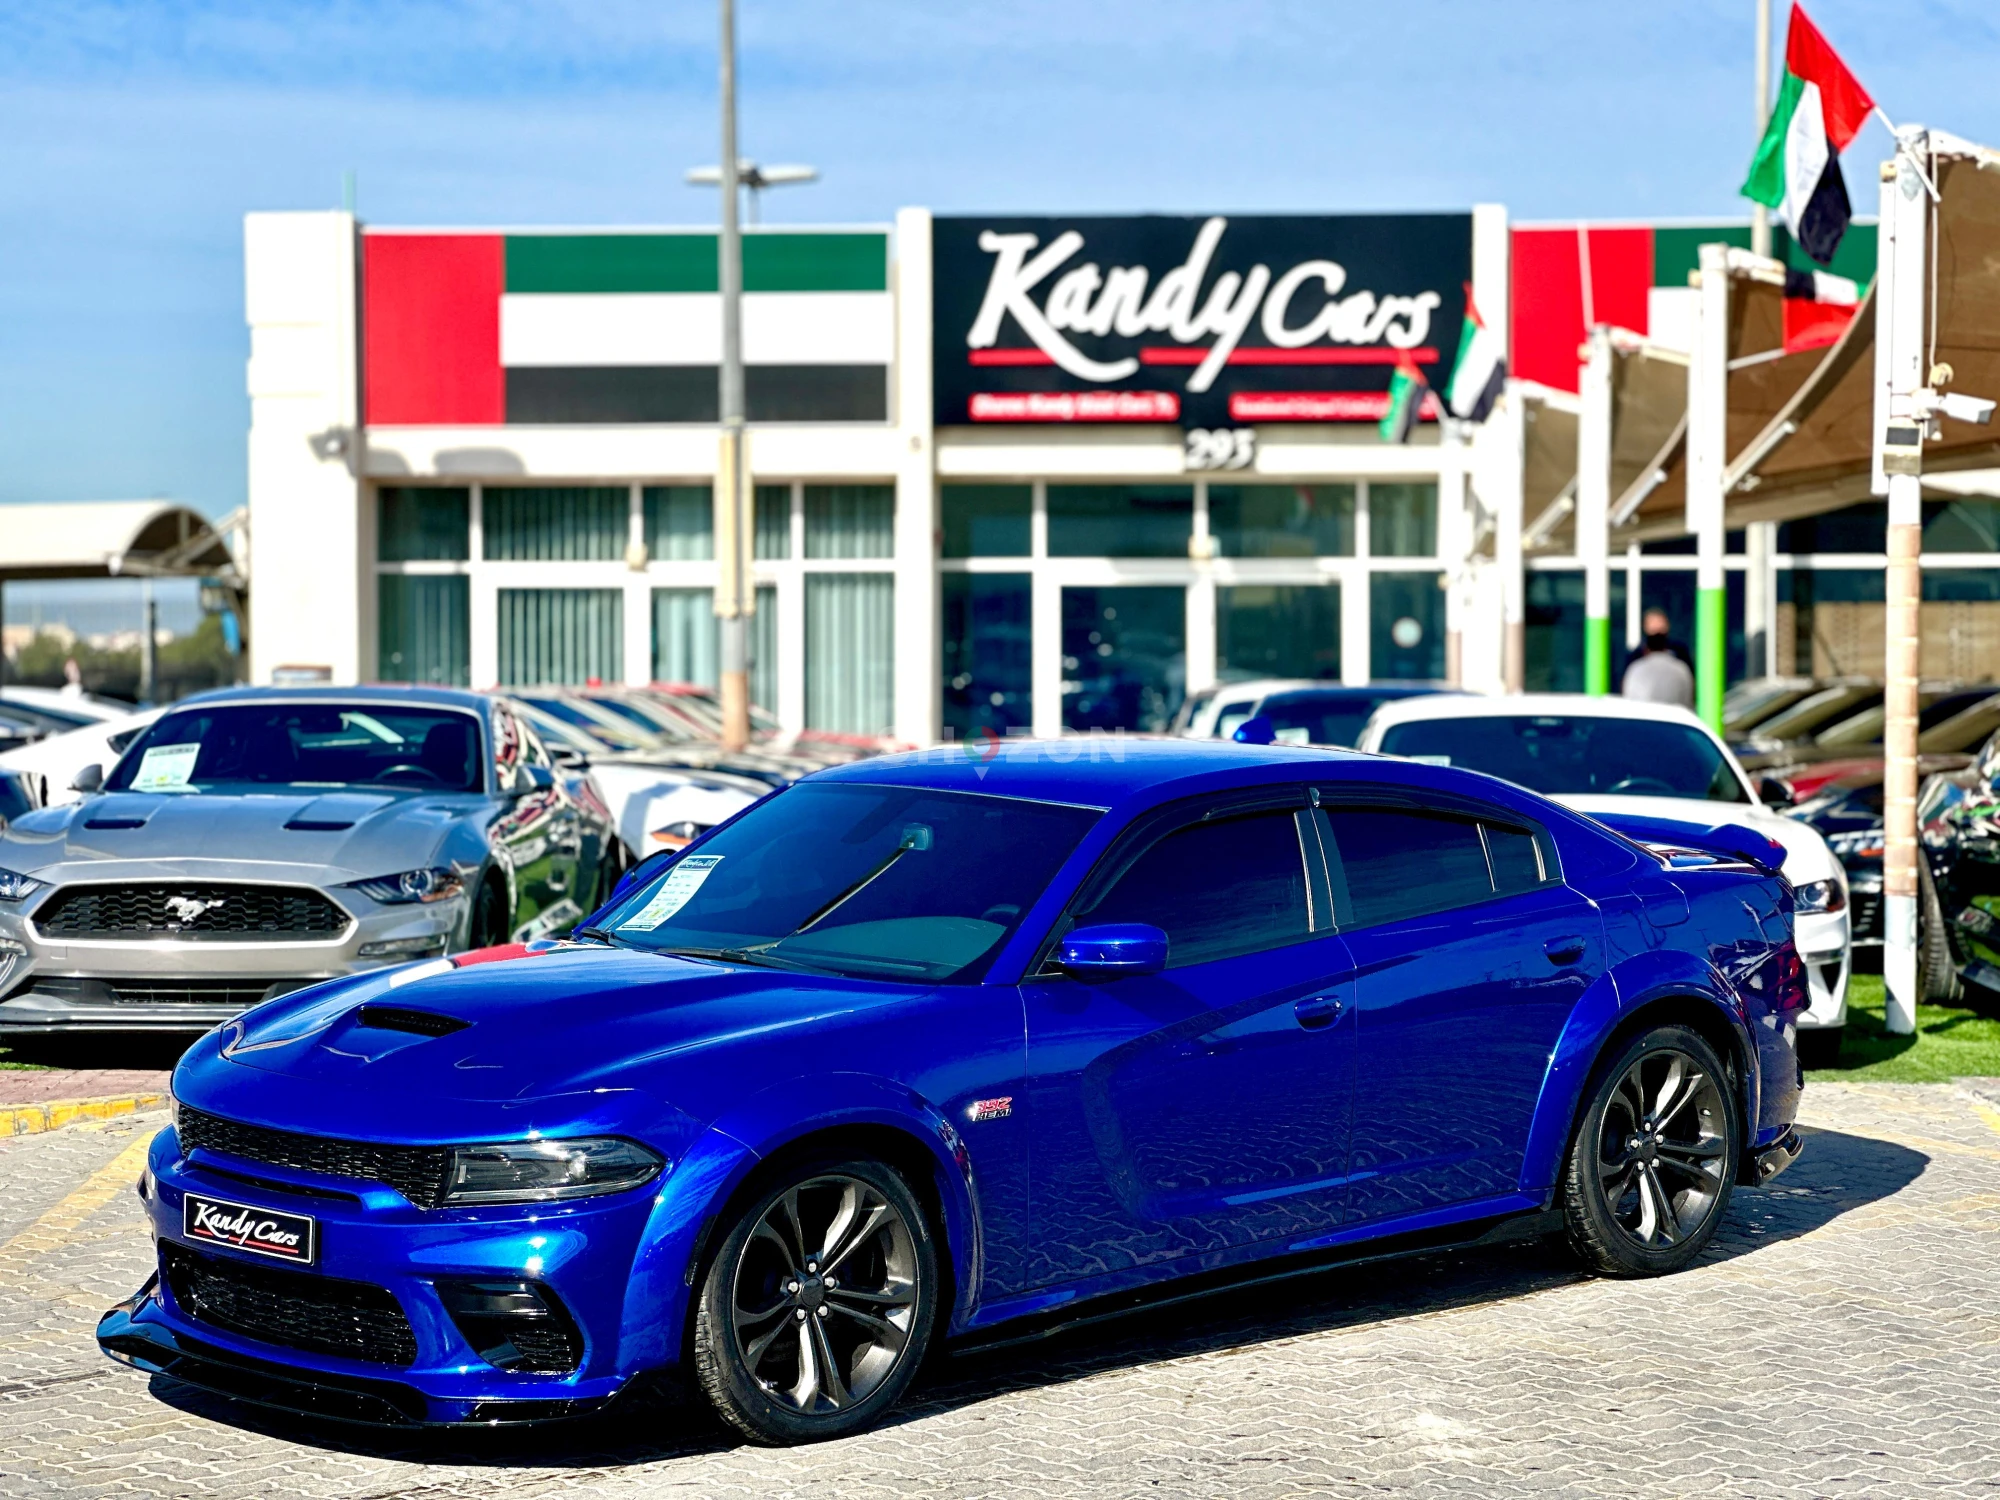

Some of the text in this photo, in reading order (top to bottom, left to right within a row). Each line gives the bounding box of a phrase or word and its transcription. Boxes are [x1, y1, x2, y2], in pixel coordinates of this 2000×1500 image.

[967, 216, 1441, 392] Kandy Cars
[1184, 428, 1256, 471] 295
[194, 1203, 300, 1246] Kandy Cars
